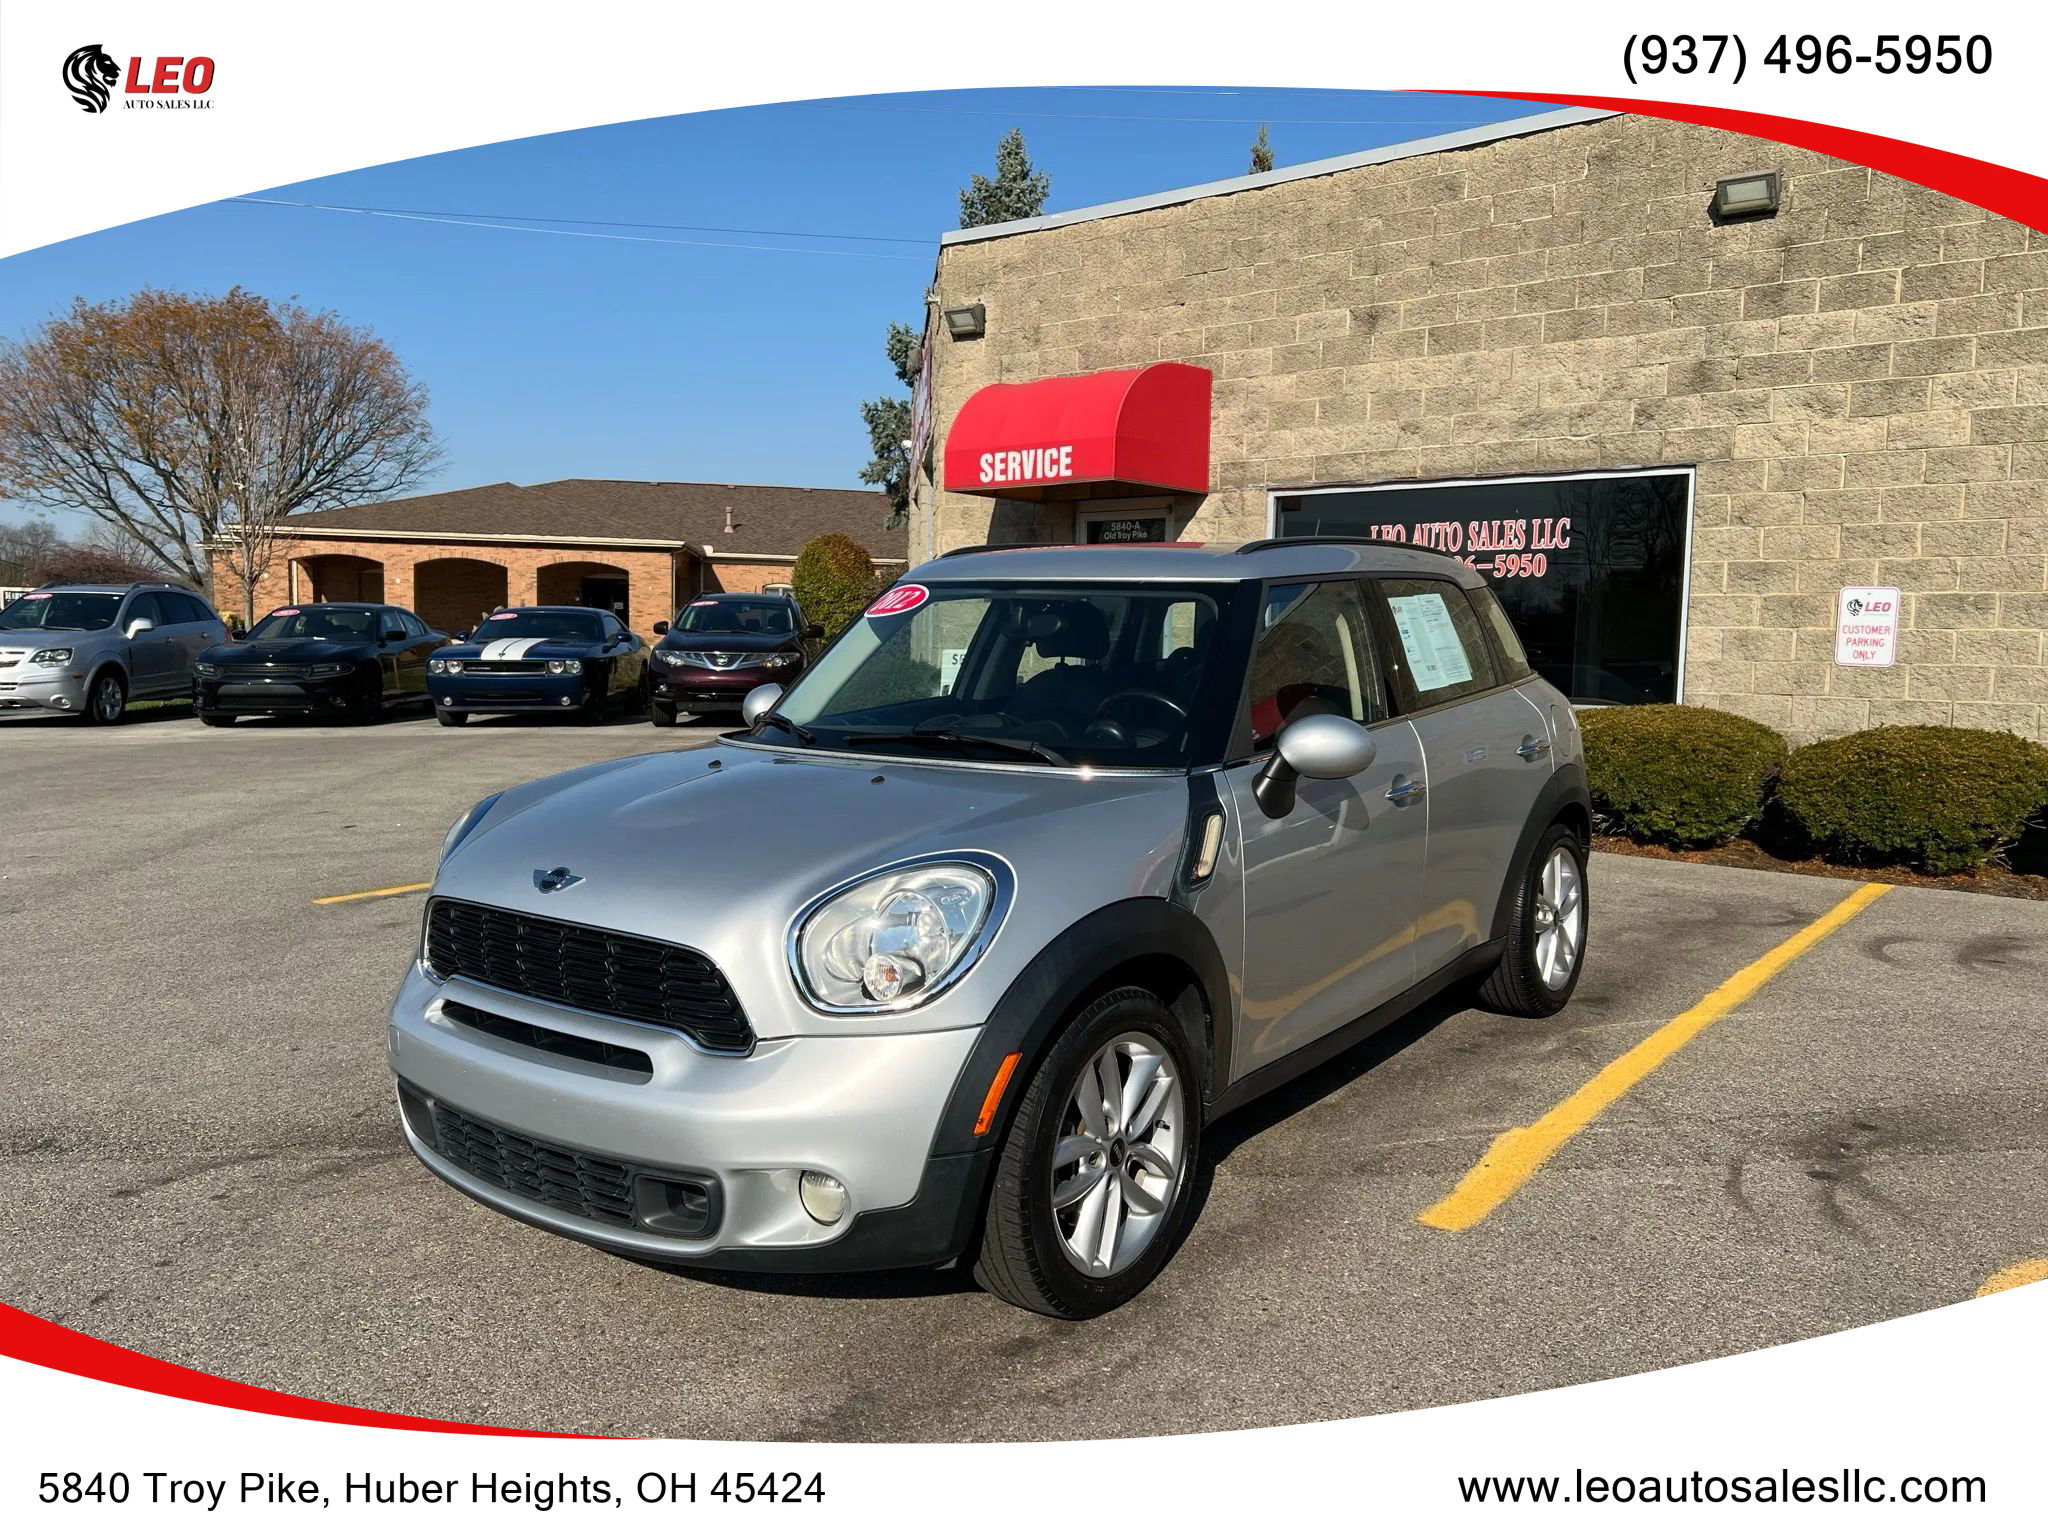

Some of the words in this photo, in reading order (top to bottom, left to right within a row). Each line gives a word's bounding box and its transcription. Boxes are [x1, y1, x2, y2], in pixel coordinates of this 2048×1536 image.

[979, 445, 1073, 483] SERVICE
[1111, 521, 1141, 531] 5840-A
[1104, 531, 1117, 540] Old
[1117, 531, 1131, 541] Troy
[1132, 530, 1148, 539] Pike
[1412, 521, 1463, 552] AUTO
[1467, 518, 1527, 551] SALES
[1531, 517, 1571, 550] LLC
[1454, 553, 1547, 578] 6-5950
[1864, 602, 1892, 613] LEO
[1842, 625, 1891, 635] CUSTOMER
[1846, 638, 1885, 648] PARKING
[1852, 650, 1877, 661] ONLY
